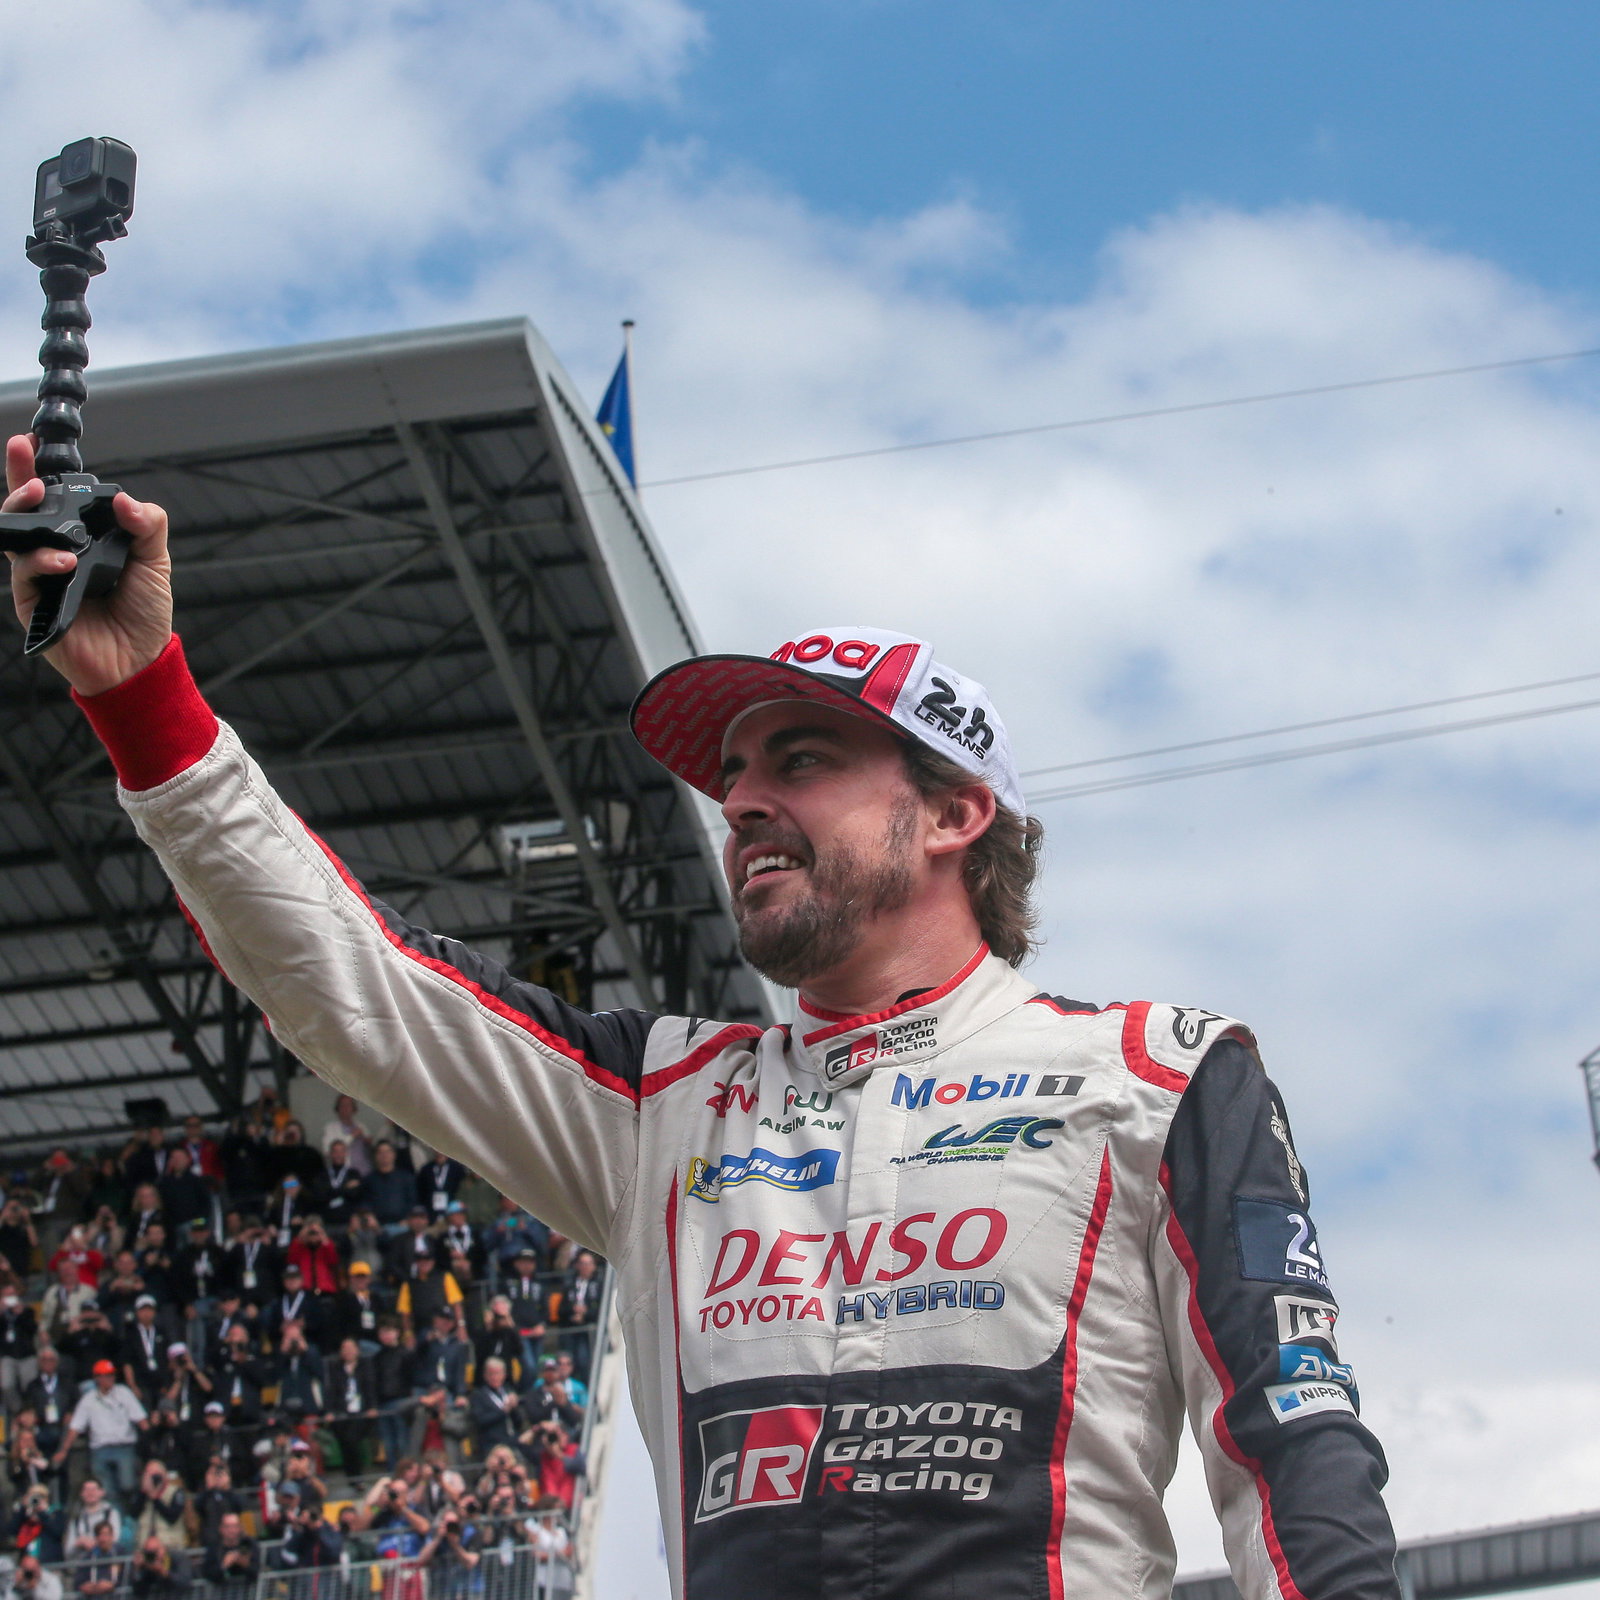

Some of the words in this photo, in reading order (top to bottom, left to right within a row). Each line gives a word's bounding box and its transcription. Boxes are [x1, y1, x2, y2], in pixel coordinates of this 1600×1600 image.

[914, 704, 939, 726] LE
[937, 719, 987, 761] MANS
[879, 1016, 938, 1038] TOYOTA
[880, 1028, 935, 1050] GAZOO
[826, 1046, 877, 1077] GR
[880, 1038, 938, 1058] Racing
[890, 1072, 1030, 1110] Mobil
[758, 1115, 806, 1135] AISIN
[810, 1118, 846, 1131] AW
[923, 1116, 1066, 1149] WEC
[908, 1151, 943, 1162] WORLD
[943, 1147, 1011, 1157] ENDURANCE
[704, 1207, 1008, 1299] DENSO
[1285, 1262, 1307, 1278] LE
[1309, 1270, 1332, 1290] MA
[699, 1294, 825, 1333] TOYOTA
[835, 1280, 1006, 1325] HYBRID
[1300, 1385, 1348, 1402] NIPPO
[831, 1402, 1023, 1431] TOYOTA
[823, 1435, 1004, 1463] GAZOO
[703, 1444, 805, 1512] GR
[817, 1463, 994, 1501] Racing
